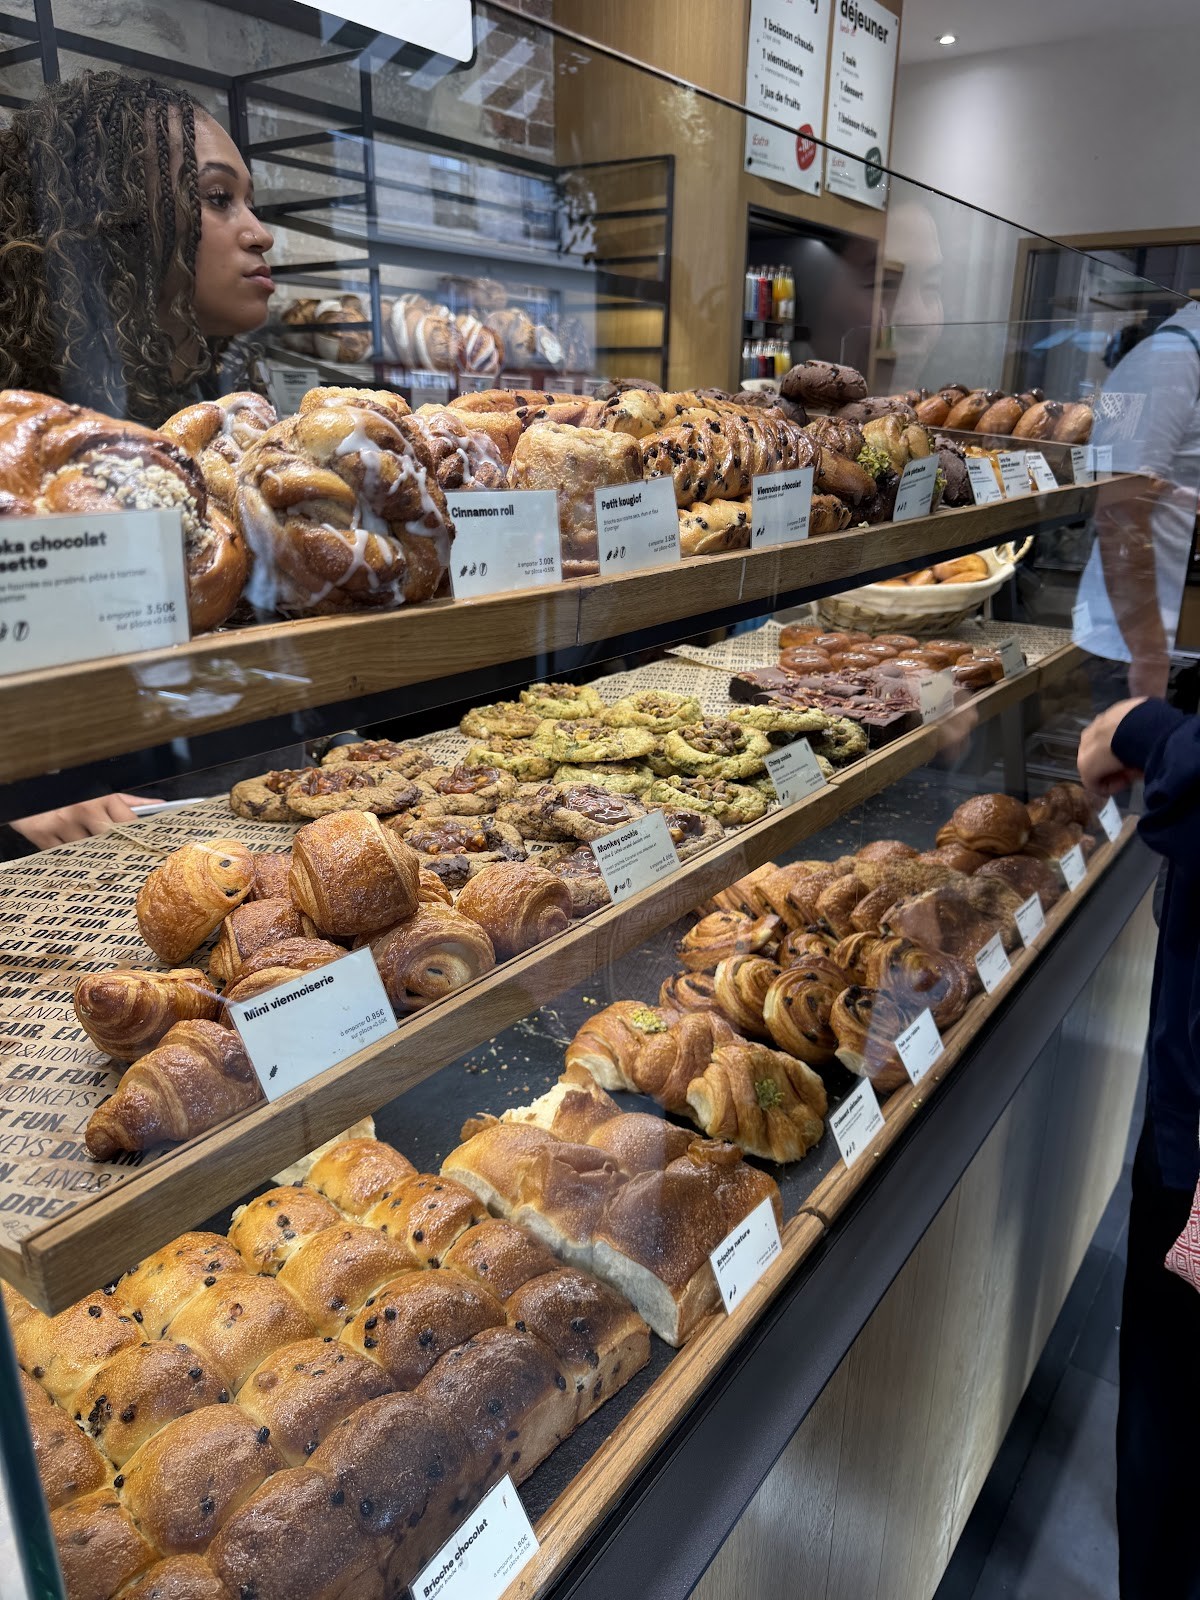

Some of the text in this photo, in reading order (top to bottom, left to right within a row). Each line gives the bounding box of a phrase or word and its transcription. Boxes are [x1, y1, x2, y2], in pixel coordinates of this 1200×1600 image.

[840, 0, 888, 44] déjeuner
[768, 19, 793, 42] boisson
[757, 480, 802, 495] Viennoise chocolat
[601, 492, 642, 510] Petit kouglof
[451, 504, 515, 519] Cinnamon roll
[29, 531, 107, 553] chocolat
[152, 826, 186, 834] EAT
[597, 837, 621, 854] Monkey
[620, 829, 639, 843] cookie
[123, 853, 158, 863] EAT
[95, 872, 131, 882] EAT
[64, 893, 103, 903] EAT
[63, 905, 132, 919] DREAM
[32, 915, 72, 926] EAT
[69, 917, 111, 930] FUN.
[29, 929, 102, 943] DREAM
[0, 939, 39, 952] EAT
[34, 942, 80, 956] FUN.
[0, 970, 43, 985] FUN.
[243, 974, 335, 1022] Mini viennoiserie
[365, 1008, 385, 1023] 0.85€
[6, 1063, 110, 1088] EAT FUN.
[8, 1111, 67, 1133] FUN.
[717, 1229, 750, 1267] Brioche nature
[423, 1518, 488, 1598] Brioche chocolat
